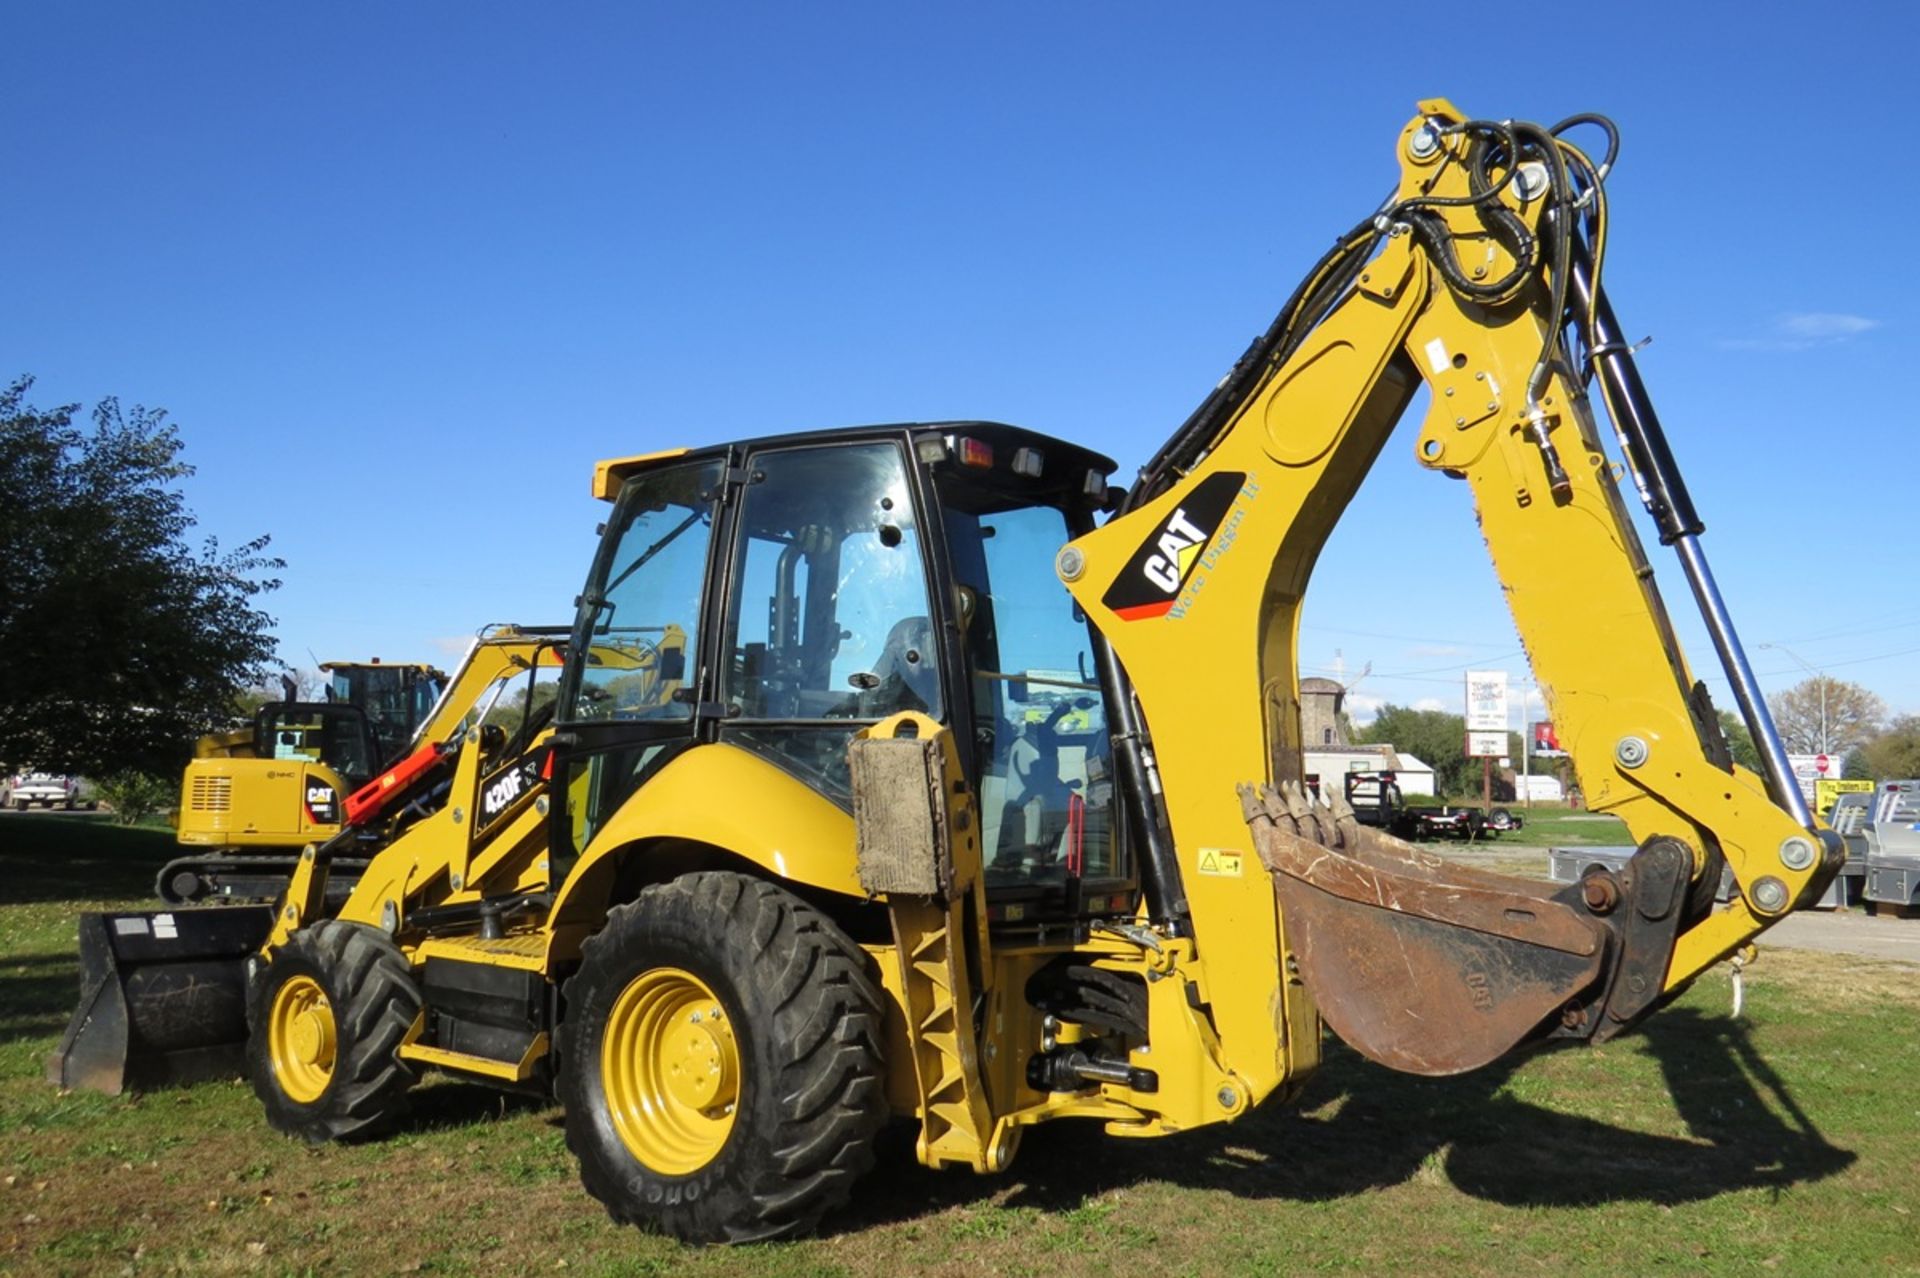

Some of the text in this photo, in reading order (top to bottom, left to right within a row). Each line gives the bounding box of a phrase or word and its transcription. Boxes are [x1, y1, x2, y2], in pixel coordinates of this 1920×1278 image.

[1143, 508, 1208, 593] CAT
[308, 787, 333, 802] CAT
[486, 768, 521, 813] 420F
